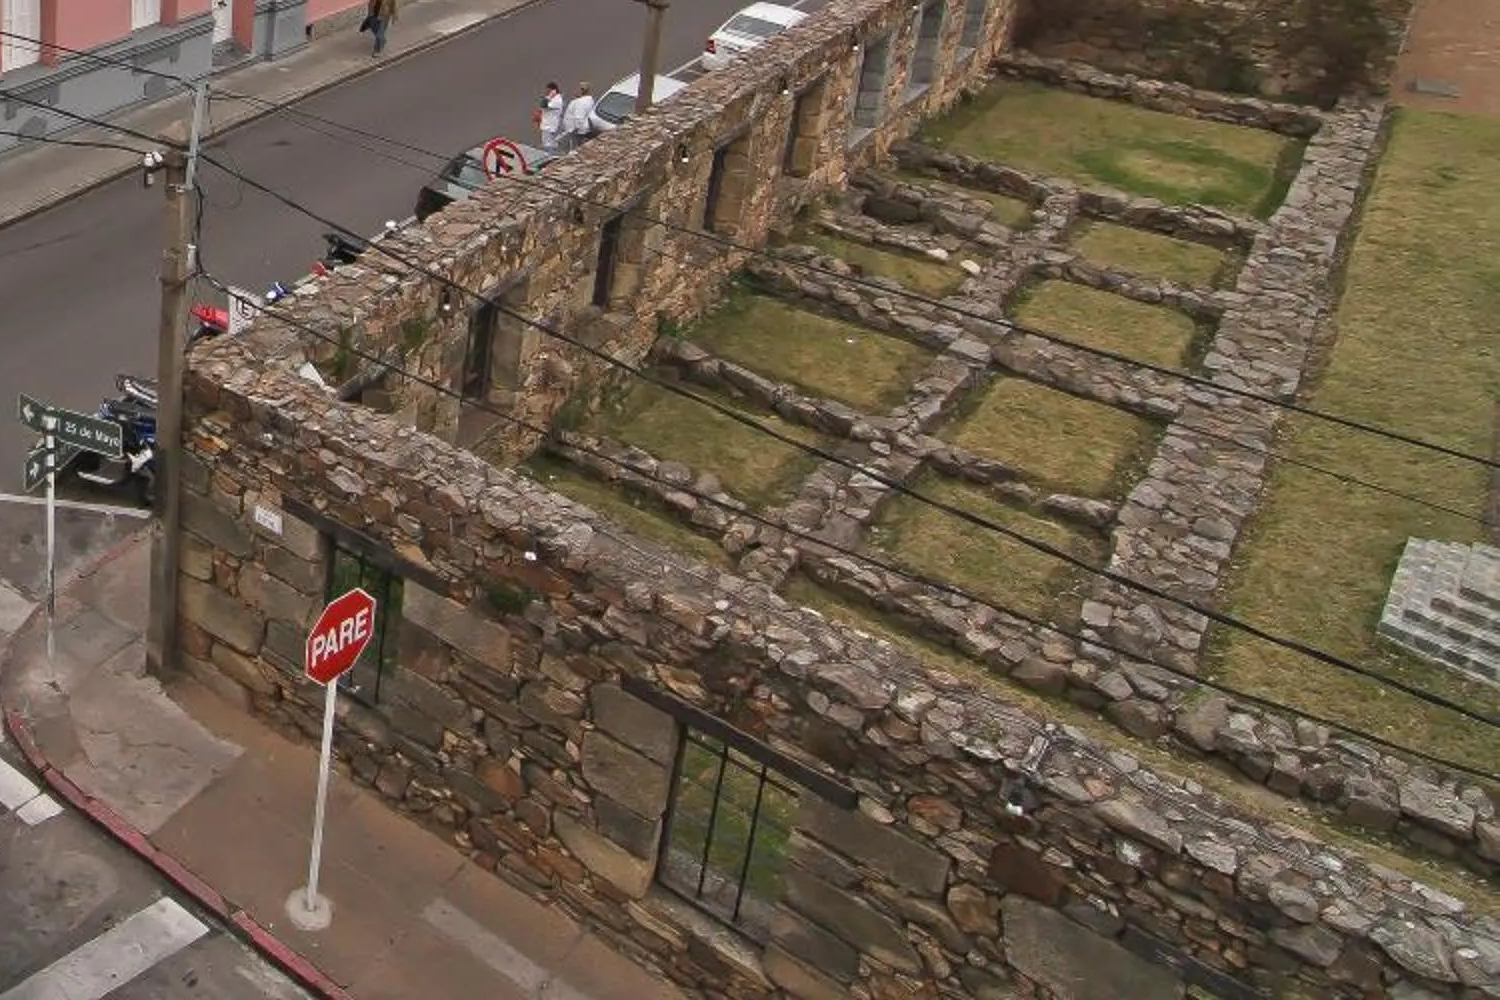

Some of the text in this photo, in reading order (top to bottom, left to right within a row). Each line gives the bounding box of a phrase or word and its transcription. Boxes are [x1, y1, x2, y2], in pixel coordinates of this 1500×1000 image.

[65, 421, 120, 447] 25 de Mayo
[311, 607, 369, 668] PARE
